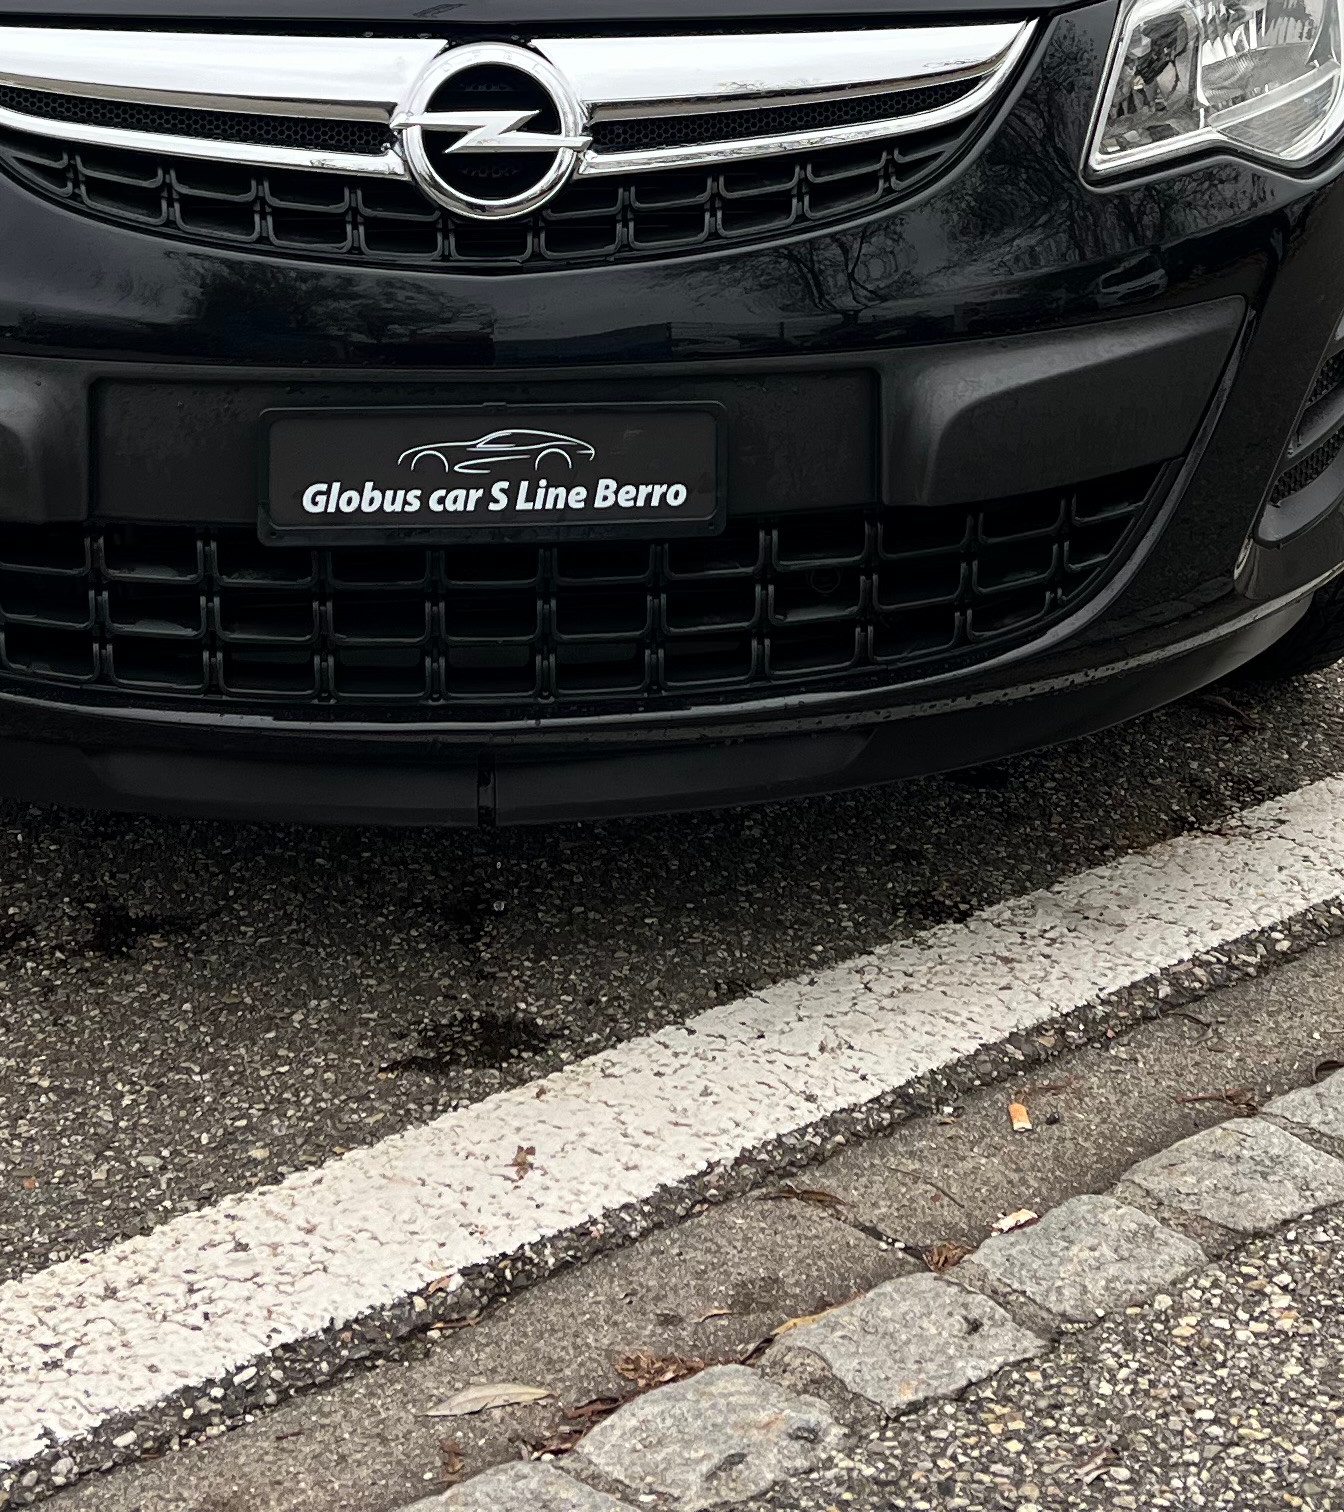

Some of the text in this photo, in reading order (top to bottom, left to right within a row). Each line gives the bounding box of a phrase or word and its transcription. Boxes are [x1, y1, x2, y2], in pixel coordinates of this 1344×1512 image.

[302, 477, 688, 514] Globus car S Line Berro
